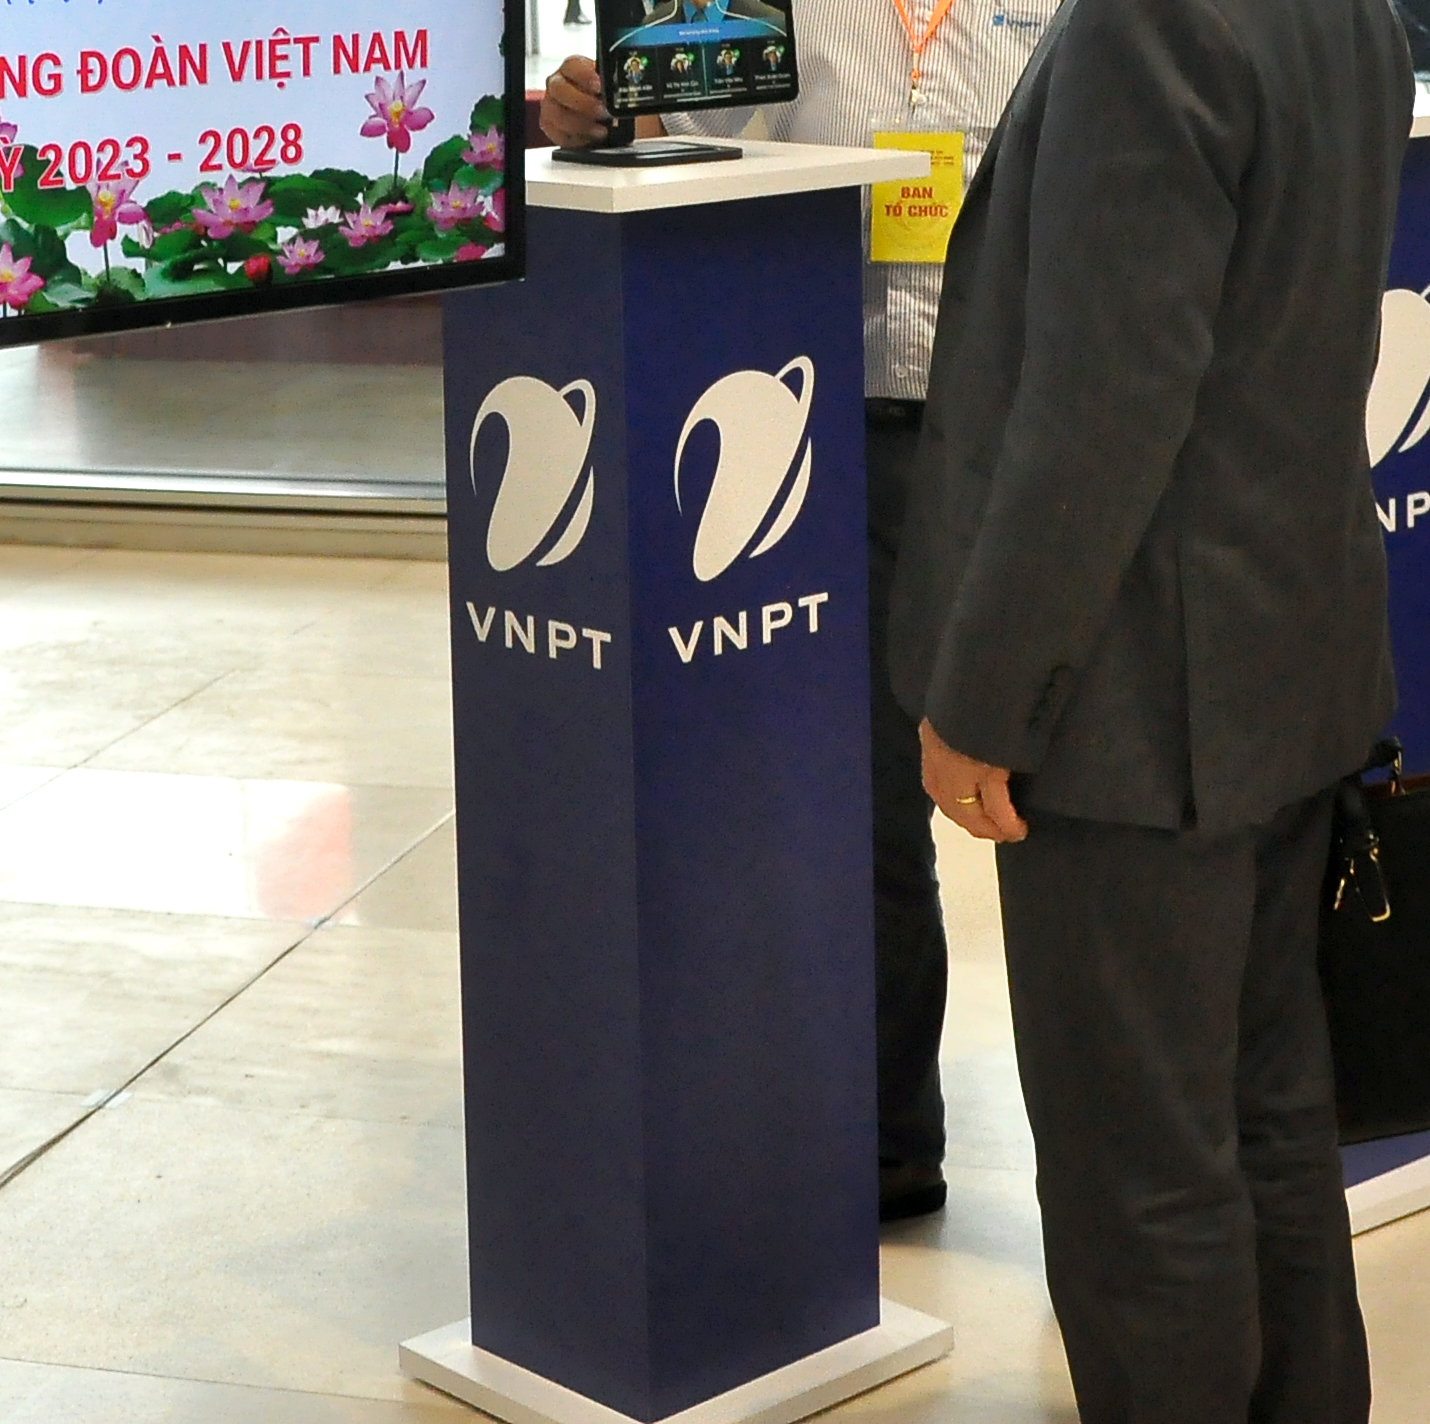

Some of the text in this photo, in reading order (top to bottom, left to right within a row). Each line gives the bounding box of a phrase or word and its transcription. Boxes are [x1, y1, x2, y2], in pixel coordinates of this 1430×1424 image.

[76, 34, 208, 94] ĐOÀN
[222, 27, 320, 90] VIỆT
[333, 28, 429, 75] NAM
[37, 135, 151, 190] 2023
[198, 122, 303, 173] 2028
[901, 186, 933, 199] BAN
[466, 601, 612, 670] VNPT
[668, 591, 829, 664] VNPT
